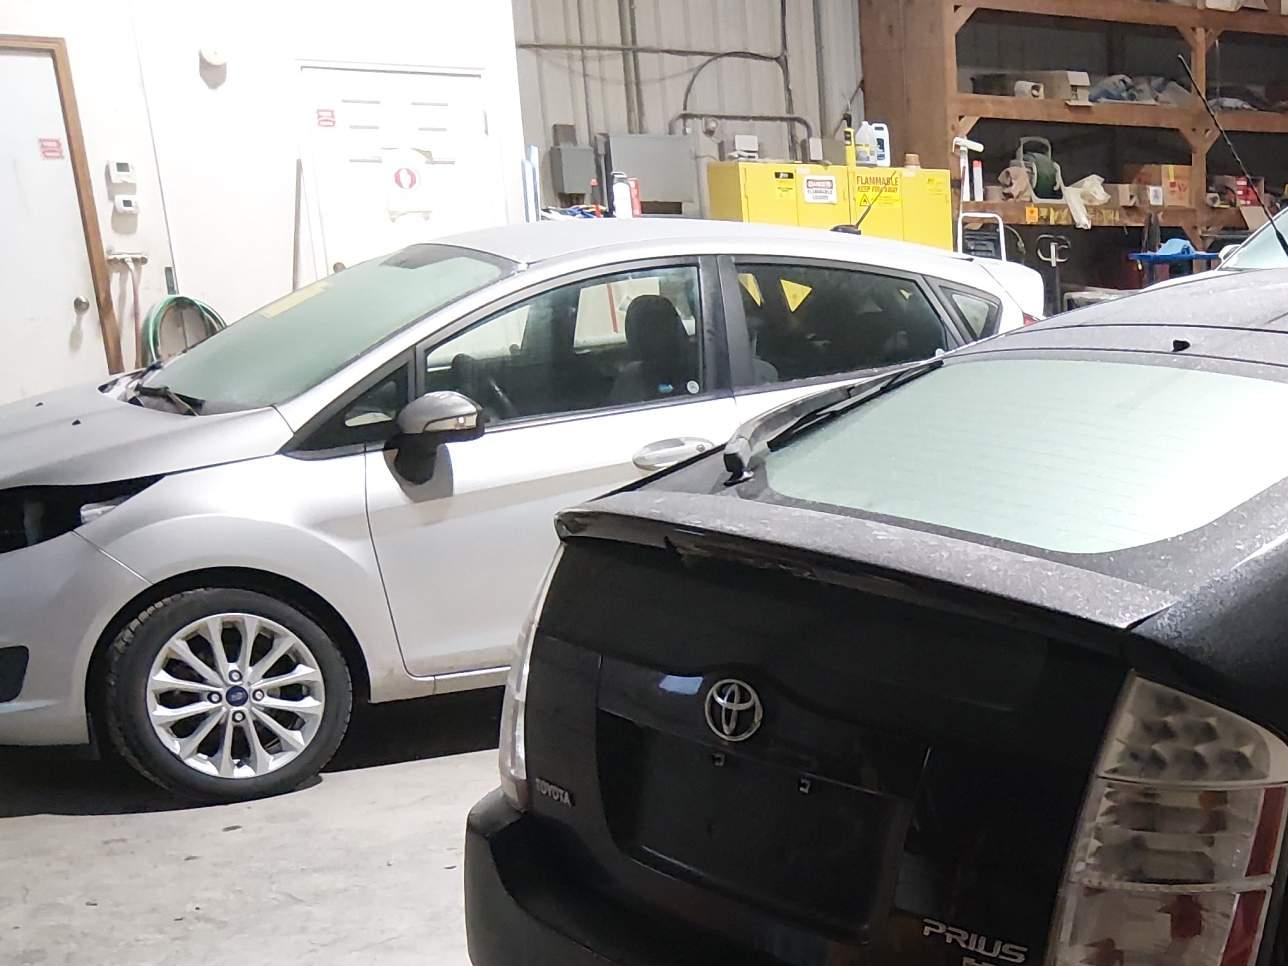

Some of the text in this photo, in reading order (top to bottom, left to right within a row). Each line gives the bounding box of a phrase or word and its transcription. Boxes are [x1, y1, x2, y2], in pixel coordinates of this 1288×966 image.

[857, 176, 898, 185] FLAMMABLE
[535, 778, 571, 808] TOYOTA
[922, 918, 1028, 963] PRIUS
